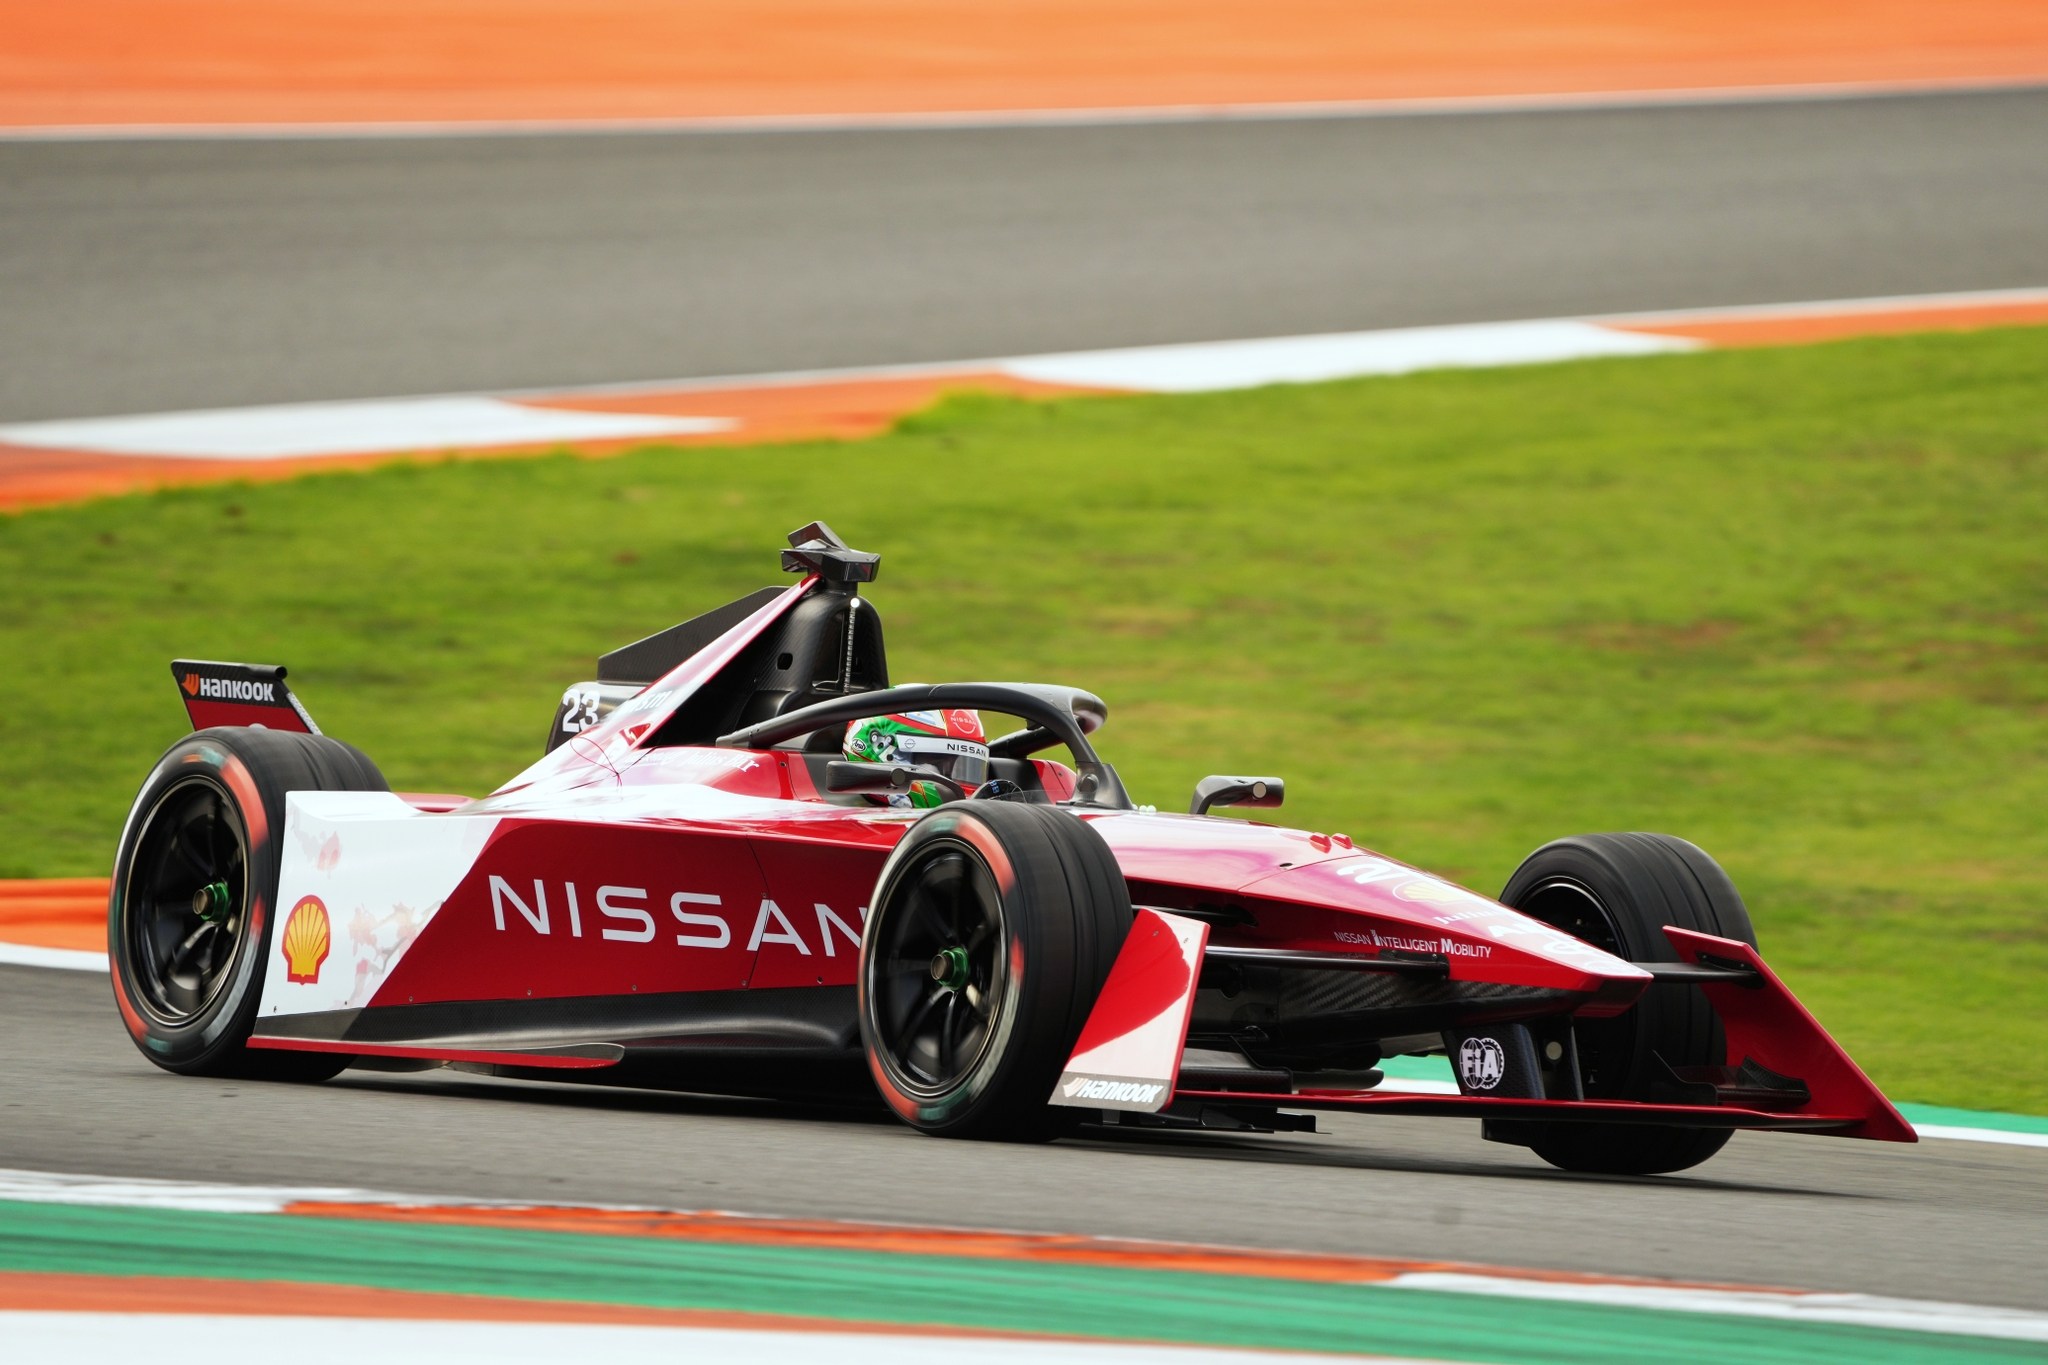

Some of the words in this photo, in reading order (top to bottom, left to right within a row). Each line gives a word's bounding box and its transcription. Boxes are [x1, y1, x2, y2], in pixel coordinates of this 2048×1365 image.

[562, 688, 600, 733] 23
[946, 743, 987, 757] NISSAN
[488, 874, 868, 957] NISSAN
[1333, 931, 1371, 945] NISSAN
